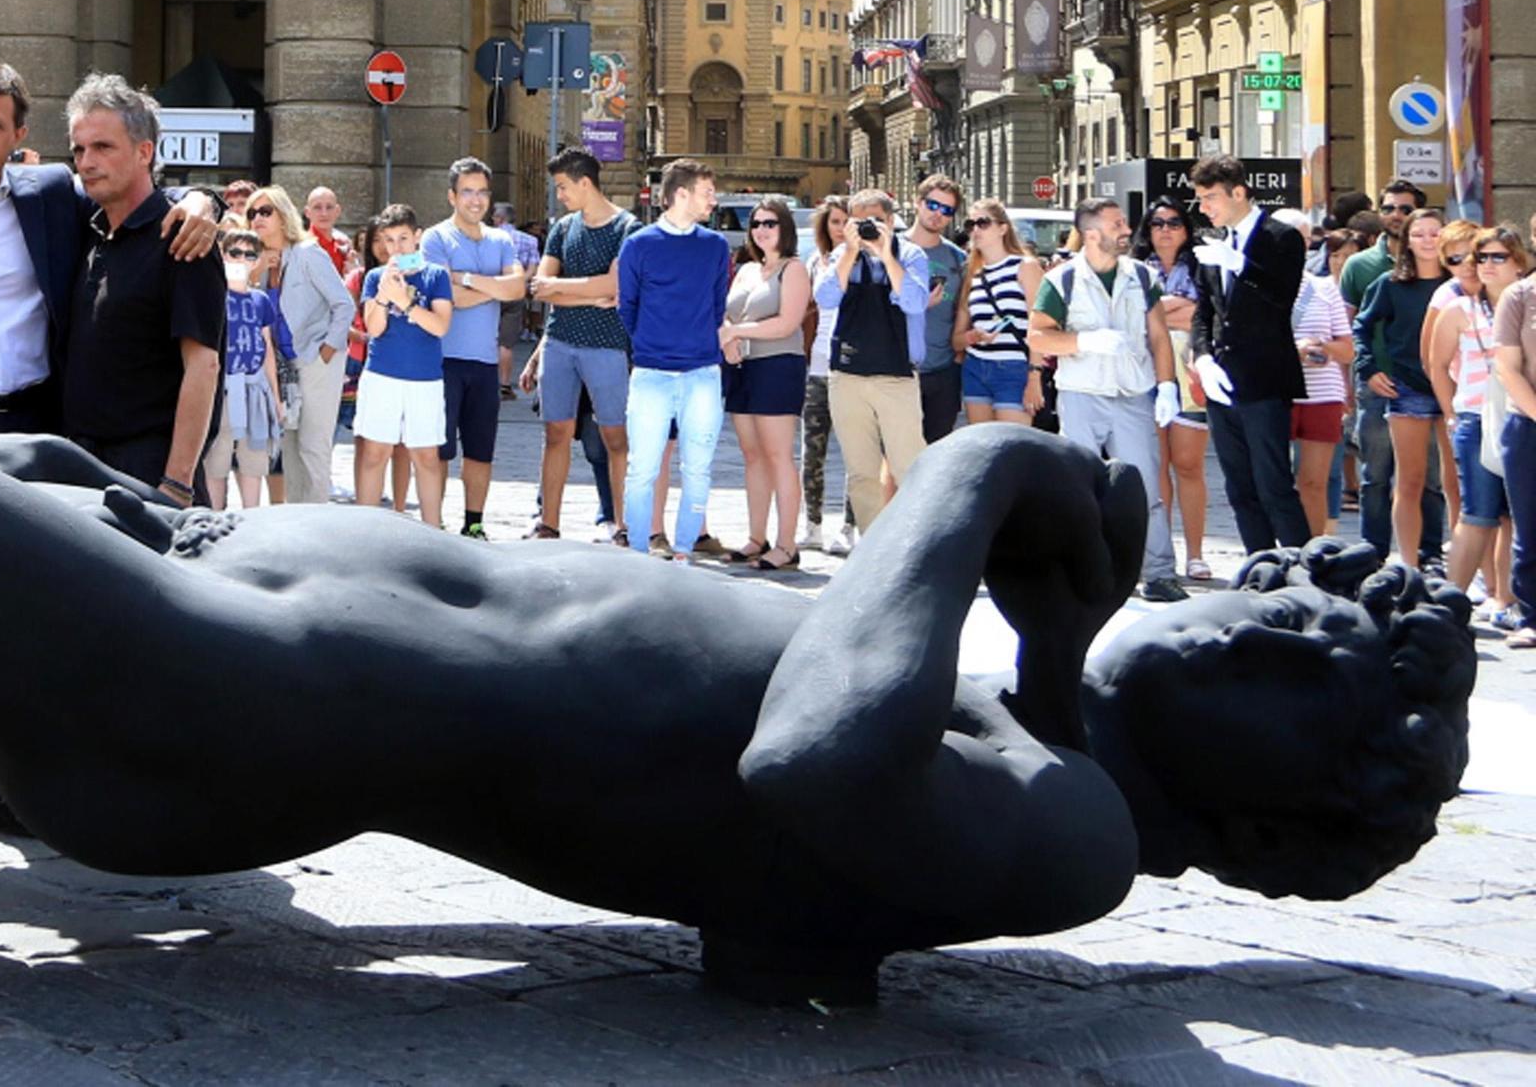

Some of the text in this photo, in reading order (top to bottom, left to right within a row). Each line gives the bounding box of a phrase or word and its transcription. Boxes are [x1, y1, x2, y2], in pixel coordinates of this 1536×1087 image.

[159, 136, 217, 161] GUE
[1033, 184, 1055, 193] STOP
[1166, 172, 1287, 189] FANERI
